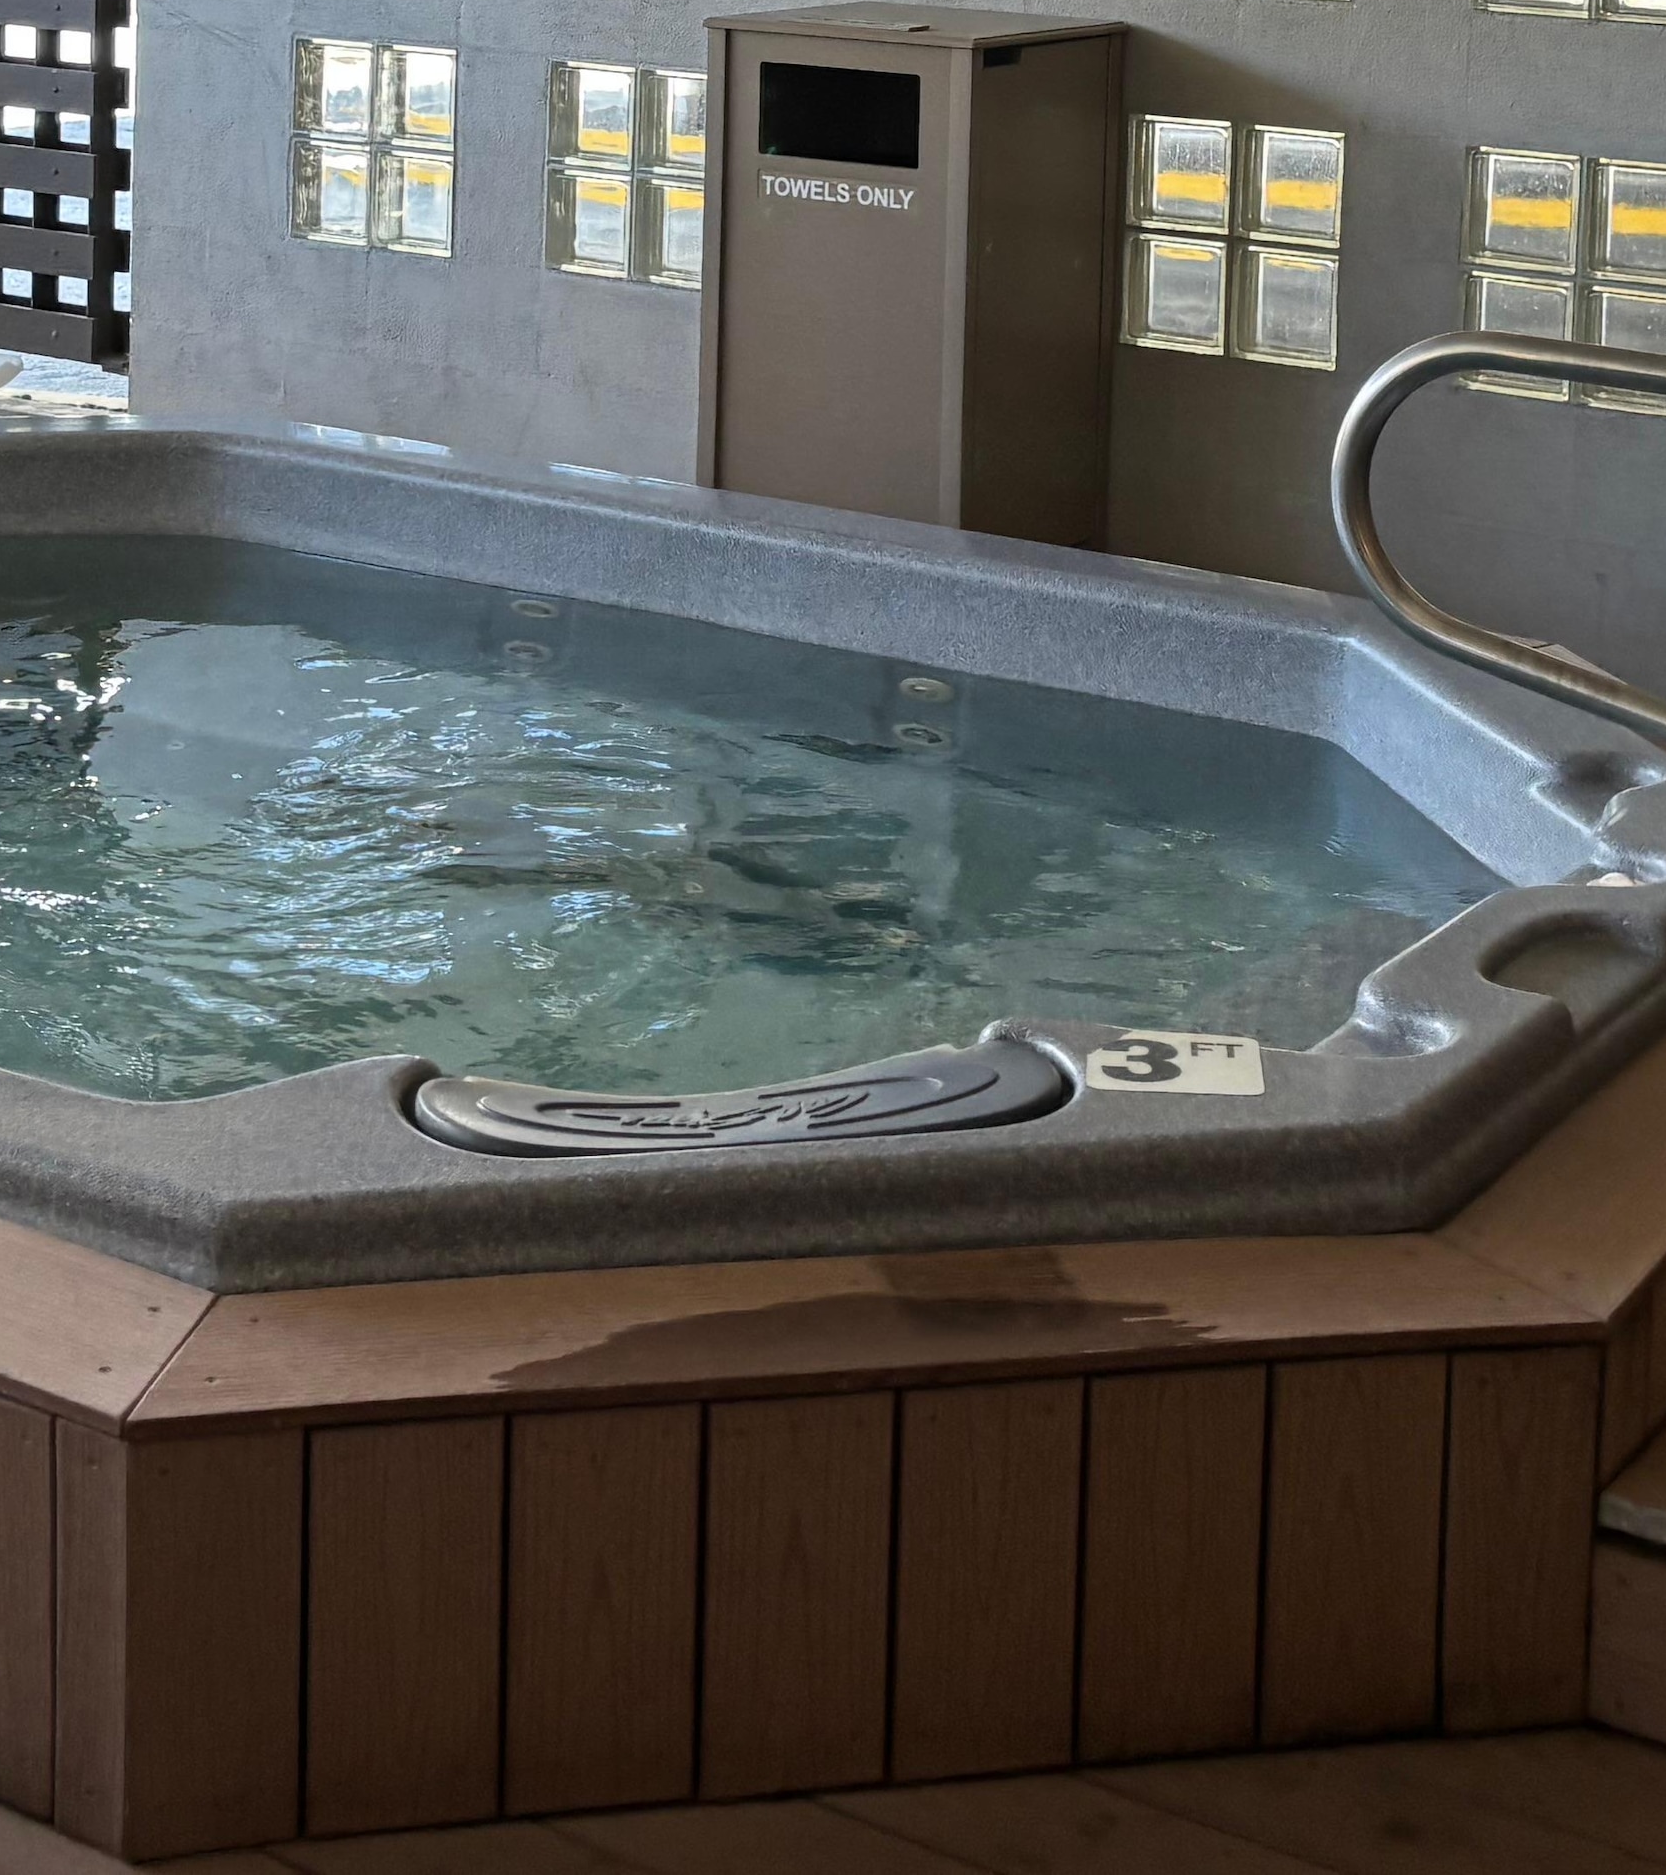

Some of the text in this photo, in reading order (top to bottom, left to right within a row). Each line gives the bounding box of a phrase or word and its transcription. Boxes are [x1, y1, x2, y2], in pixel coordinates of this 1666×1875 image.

[761, 175, 915, 210] TOWELS ONLY
[1101, 1038, 1244, 1083] 3 FT
